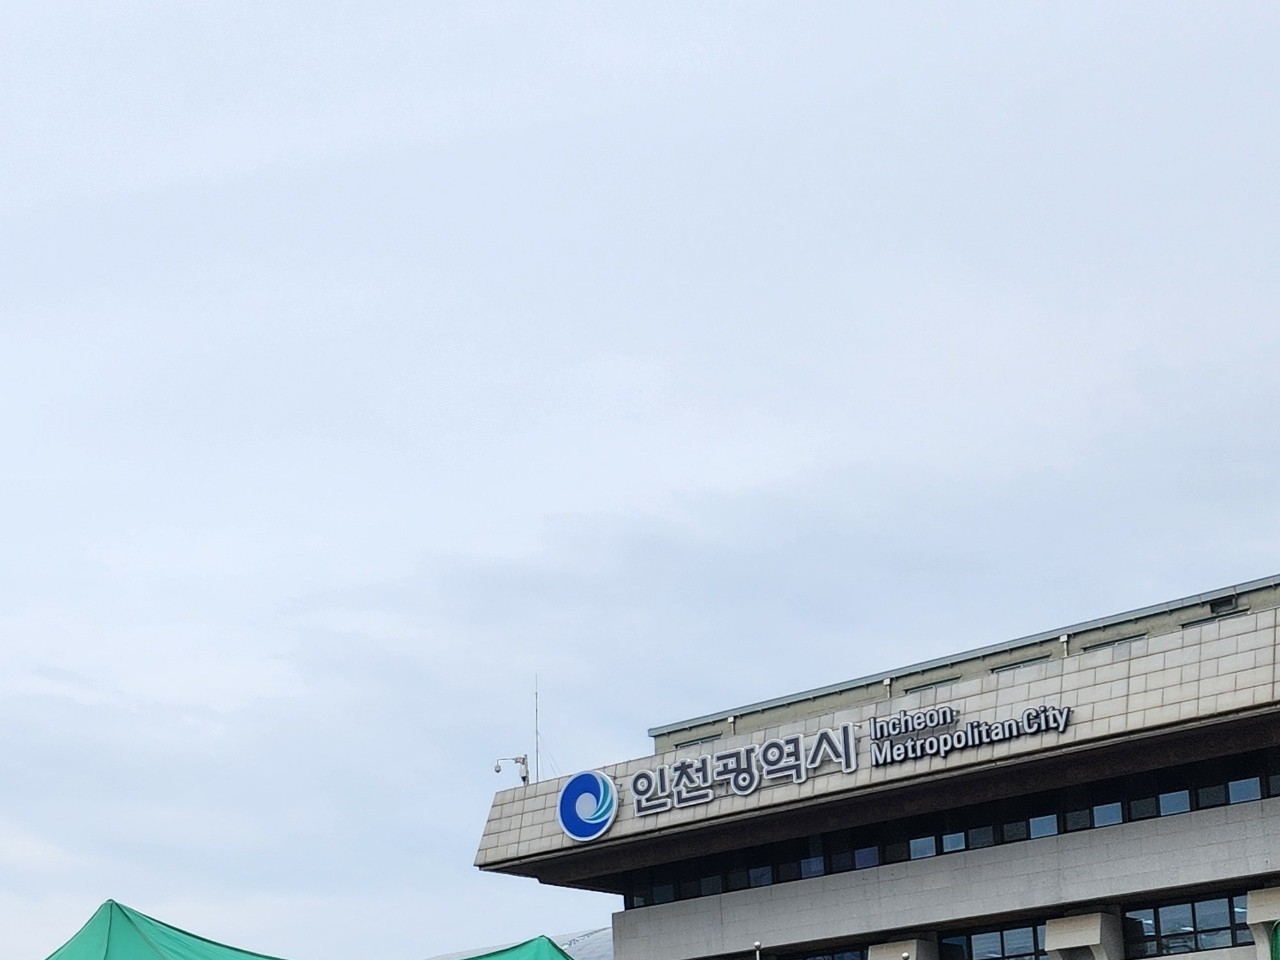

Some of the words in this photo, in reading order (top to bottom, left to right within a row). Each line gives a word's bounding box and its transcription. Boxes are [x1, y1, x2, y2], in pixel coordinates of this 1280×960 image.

[868, 704, 955, 741] Incheon
[870, 716, 1019, 768] Metropolitan
[1019, 702, 1073, 735] City
[631, 722, 858, 817] 인천광역시
